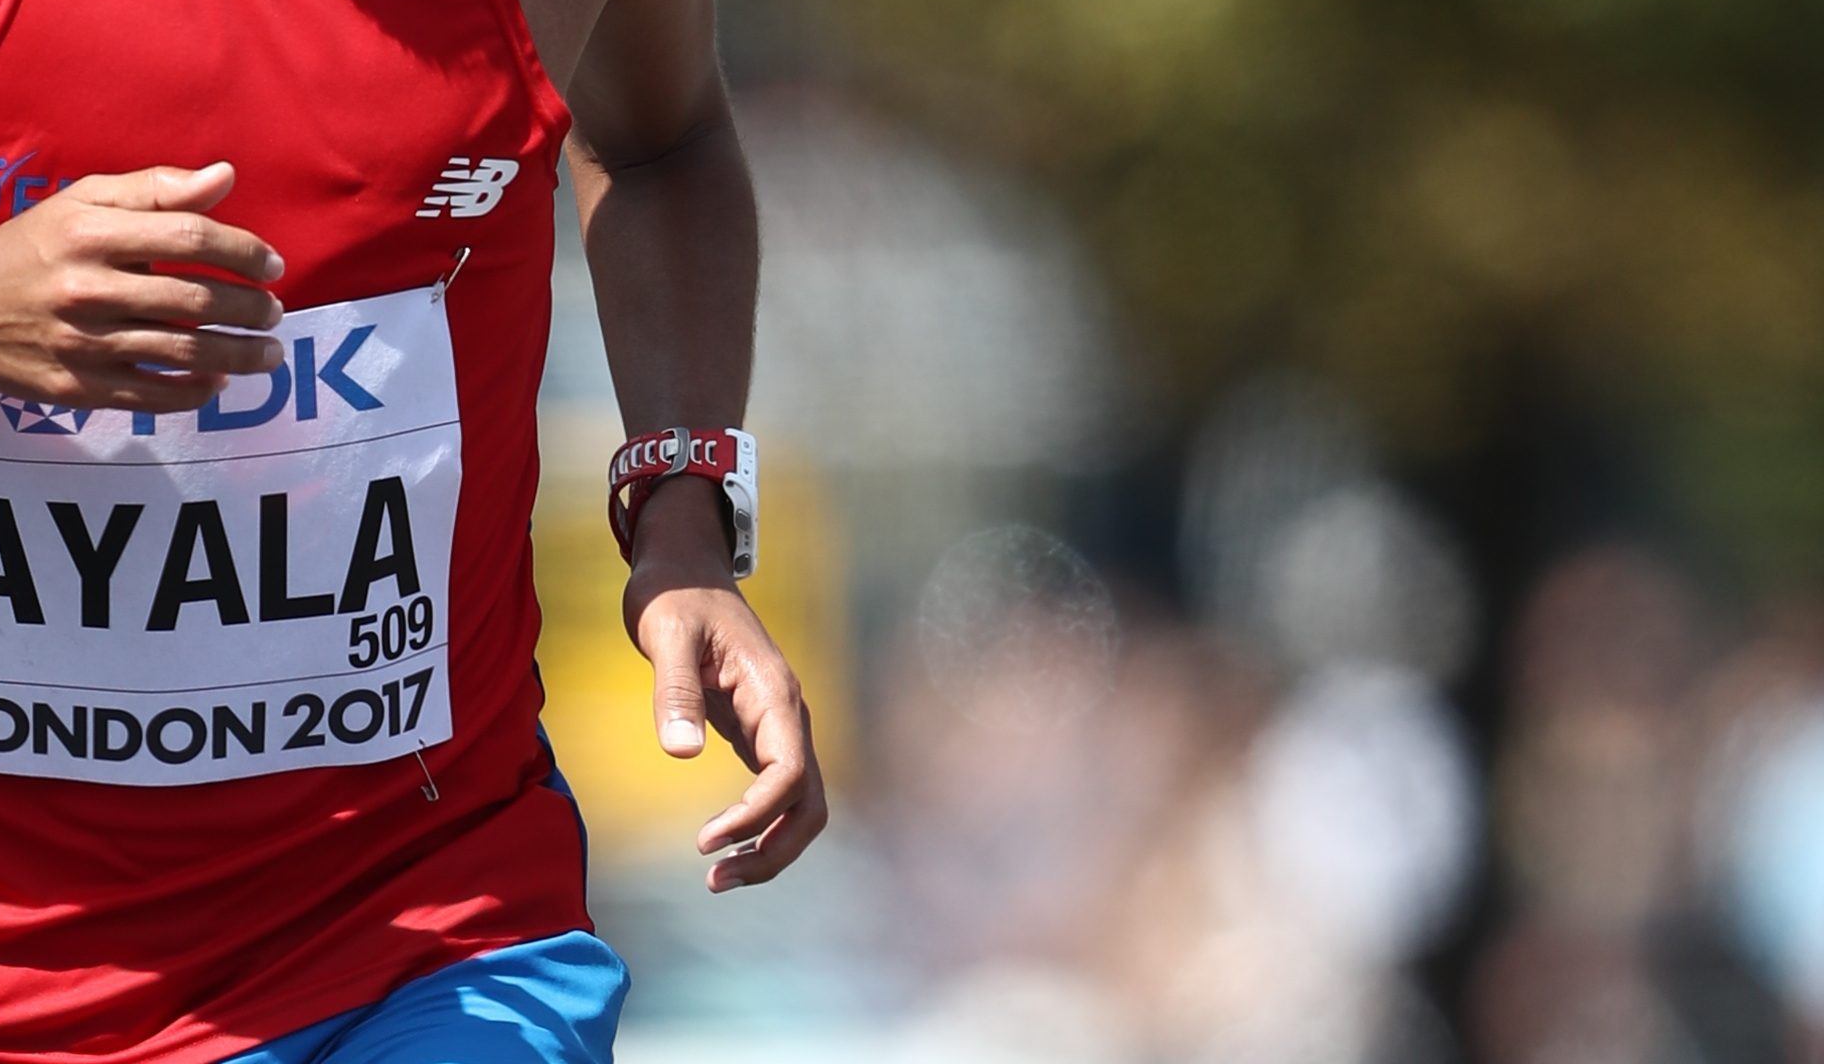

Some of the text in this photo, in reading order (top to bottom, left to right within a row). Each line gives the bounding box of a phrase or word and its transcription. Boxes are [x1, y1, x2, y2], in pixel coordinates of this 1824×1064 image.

[131, 323, 386, 436] DK
[348, 595, 434, 669] 509
[281, 666, 435, 751] 2017
